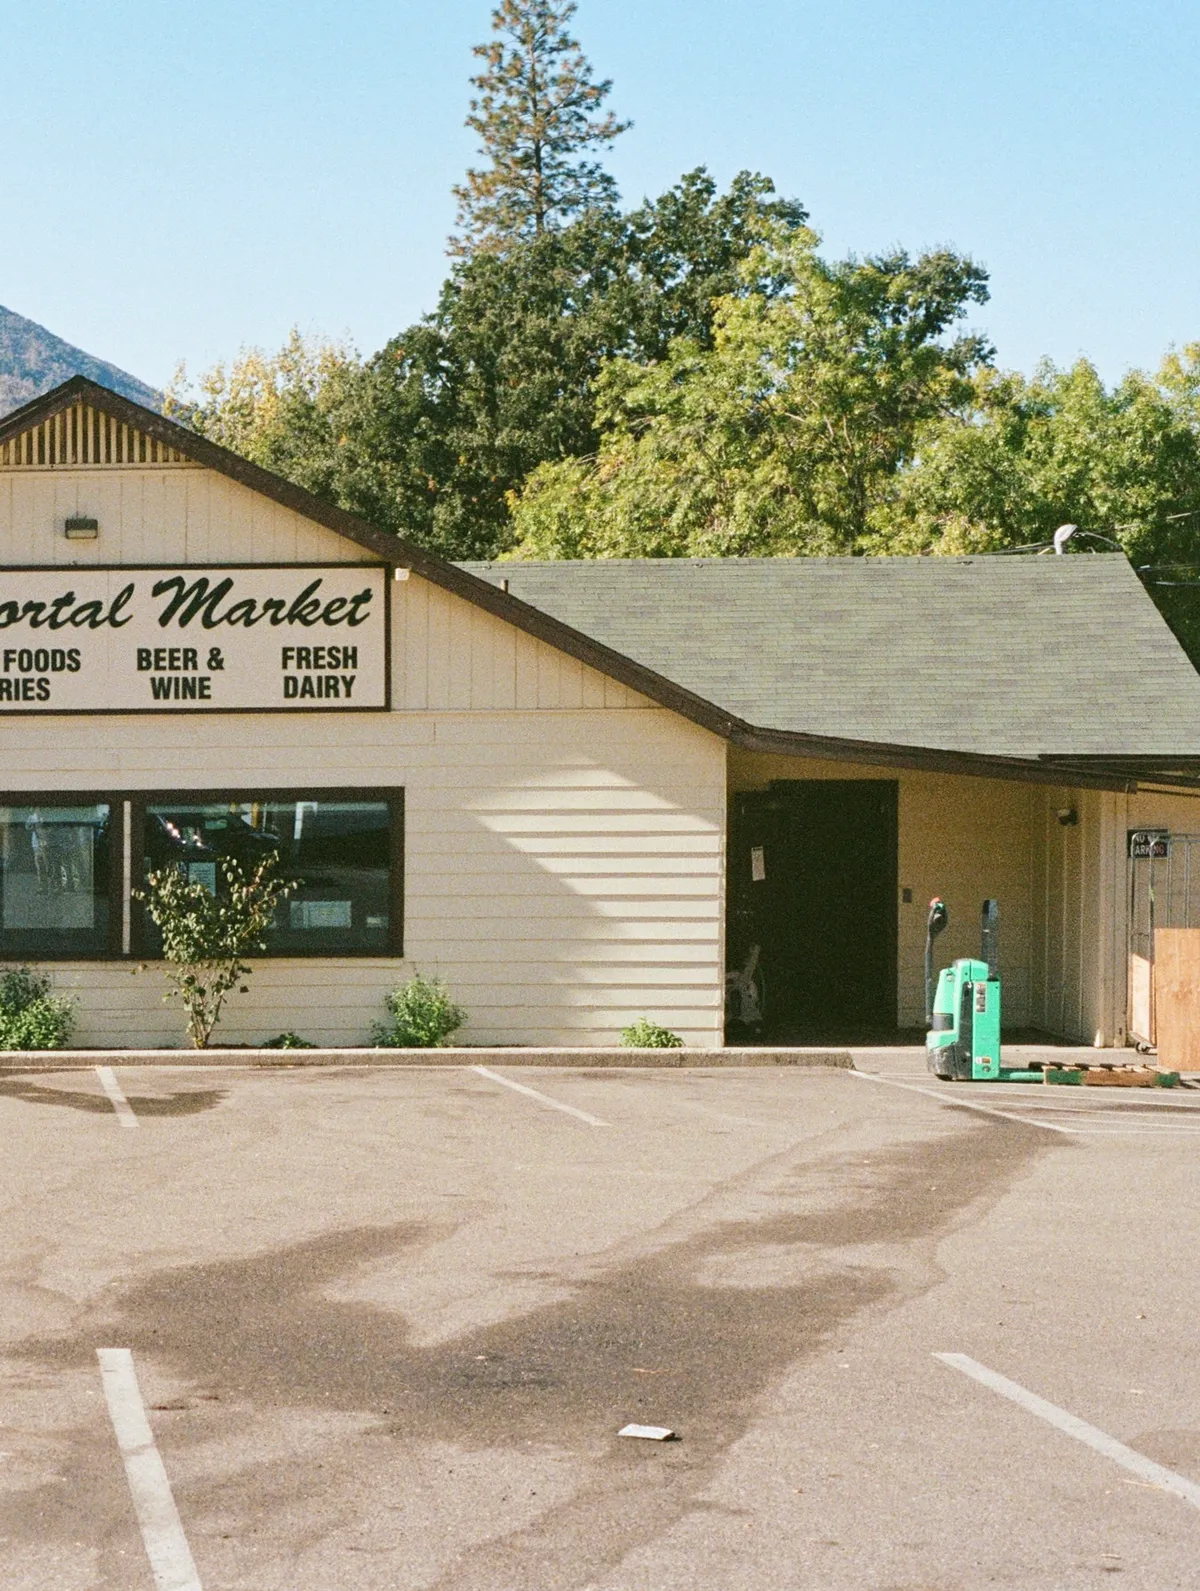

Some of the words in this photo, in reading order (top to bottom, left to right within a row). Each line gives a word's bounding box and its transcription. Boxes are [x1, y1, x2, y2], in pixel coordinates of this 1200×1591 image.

[151, 575, 374, 630] Market
[3, 648, 82, 673] FOODS
[136, 647, 198, 671] BEER
[206, 647, 225, 671] &
[282, 645, 358, 670] FRESH
[150, 676, 212, 700] WINE
[283, 675, 356, 699] DAIRY
